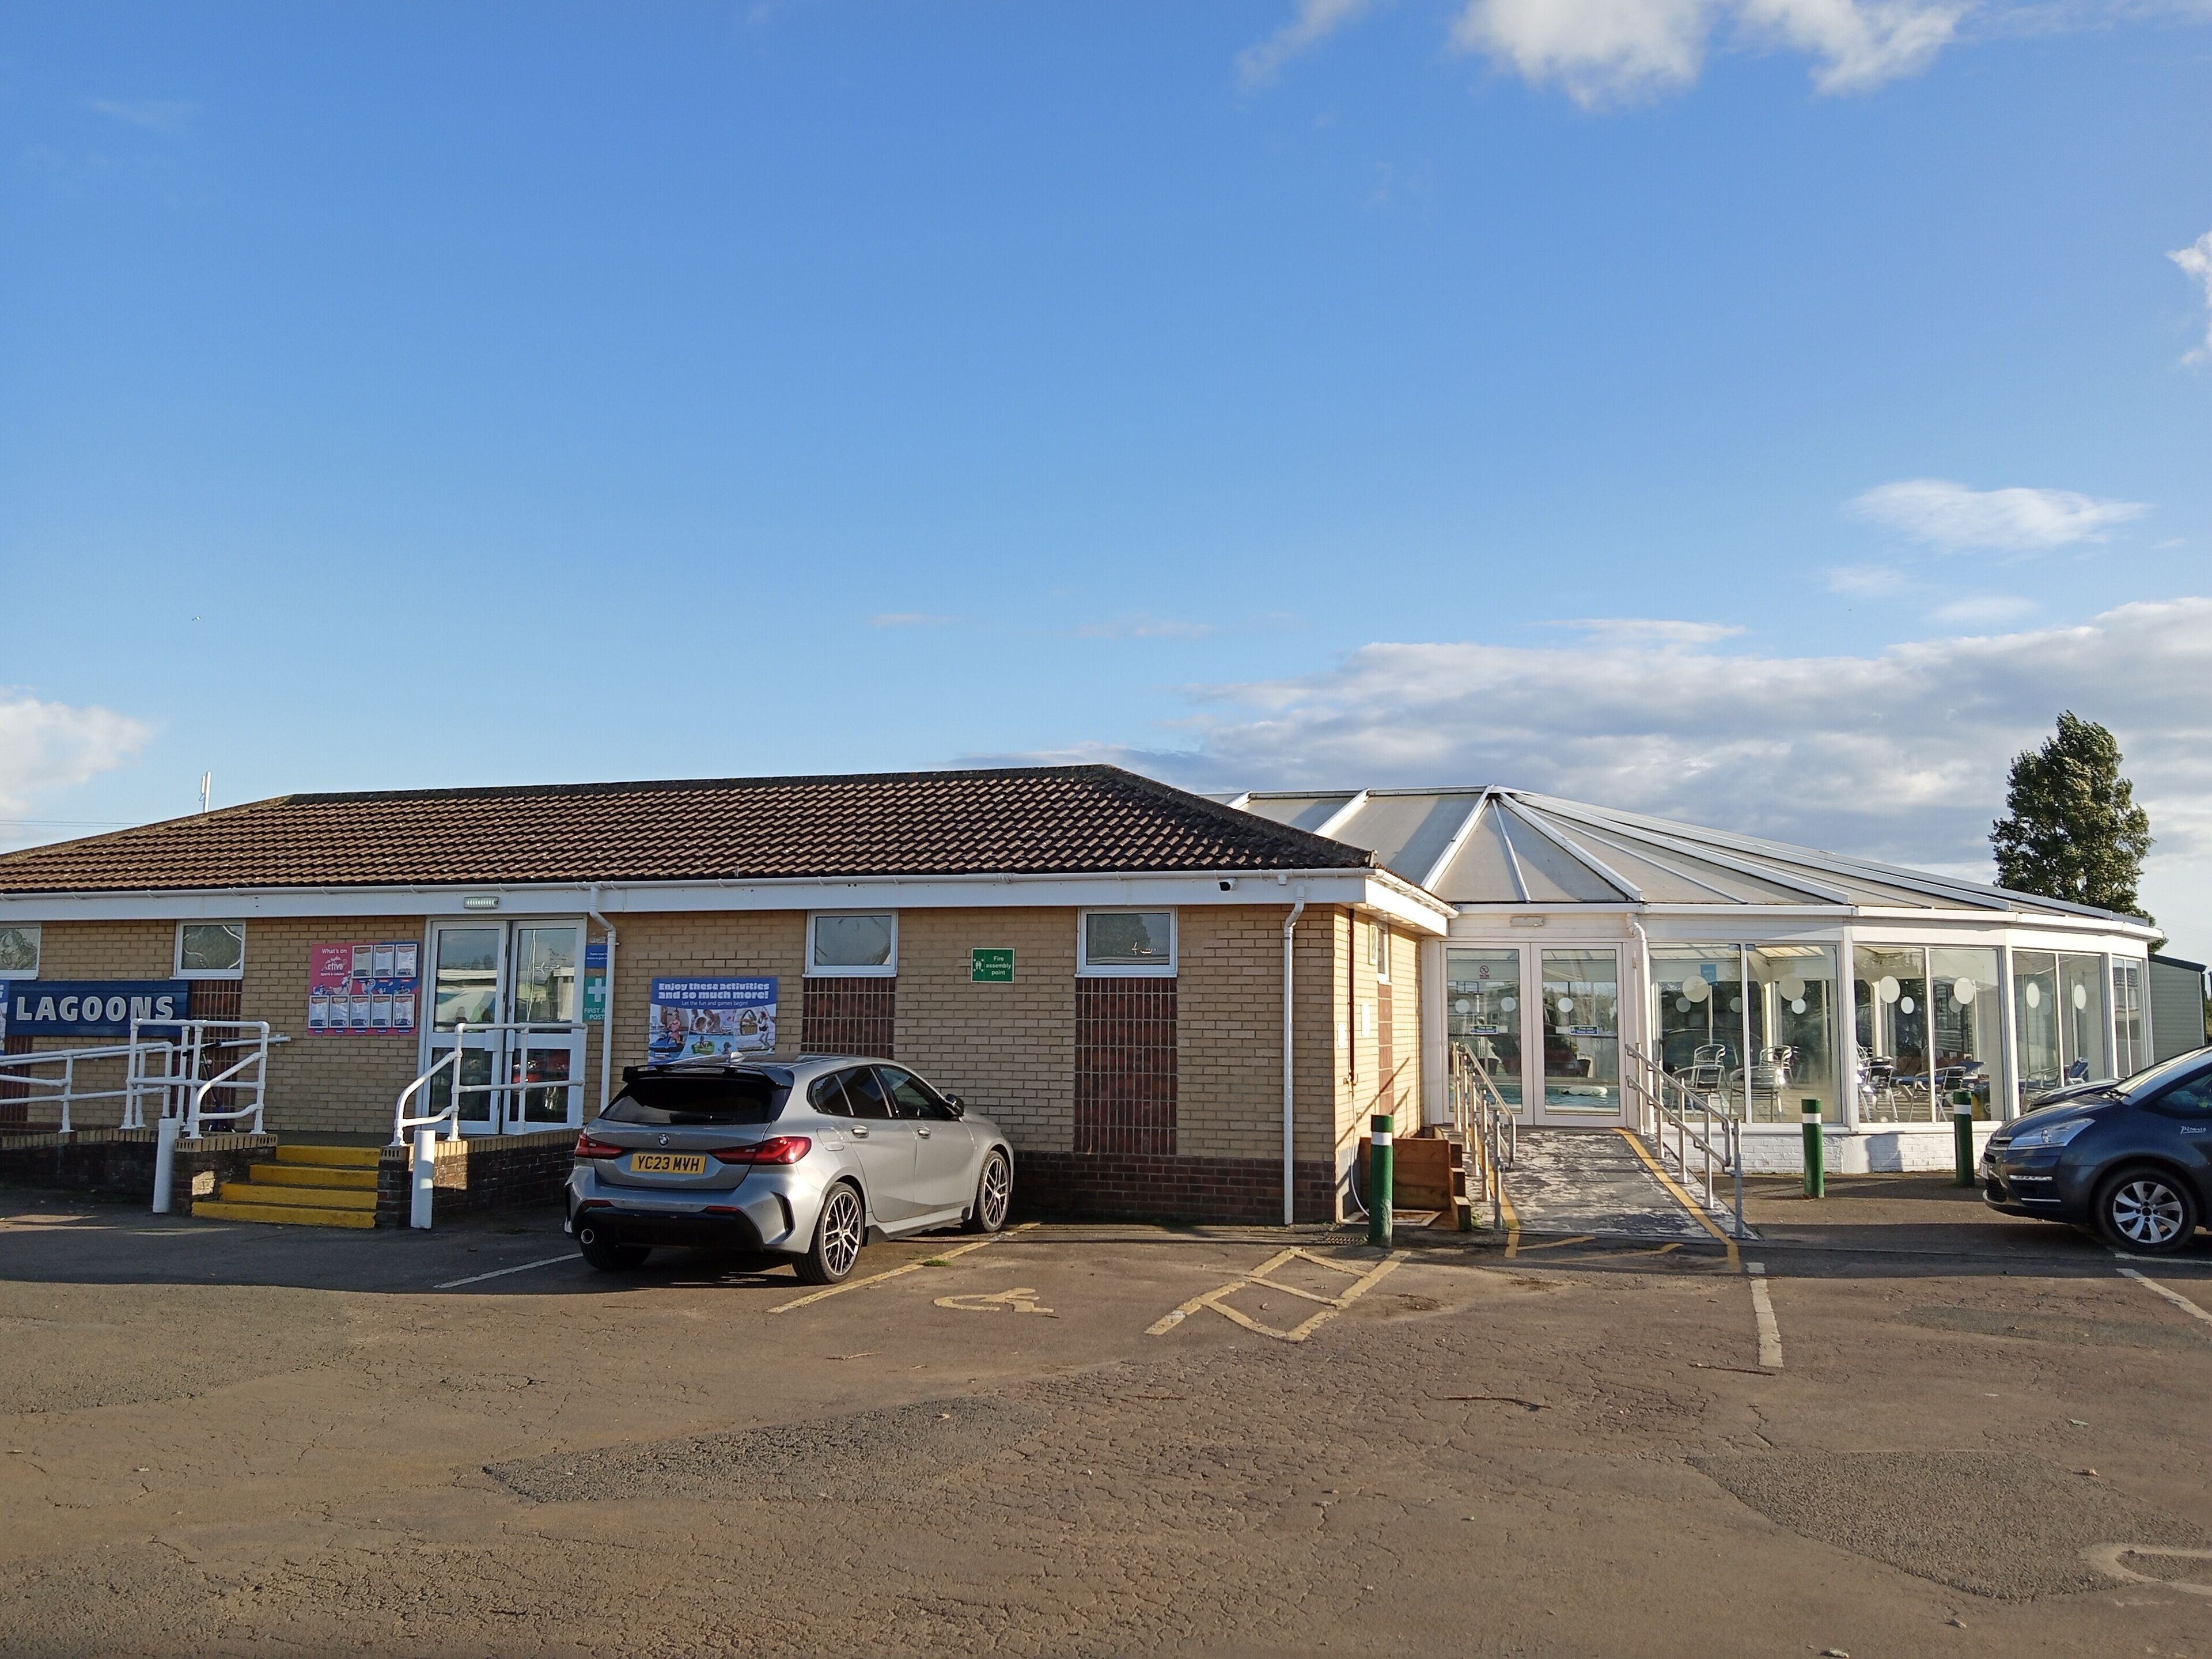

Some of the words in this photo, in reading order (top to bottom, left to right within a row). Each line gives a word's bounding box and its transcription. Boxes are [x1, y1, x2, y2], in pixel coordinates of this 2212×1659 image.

[658, 983, 688, 991] Enjoy
[658, 991, 680, 999] and
[698, 991, 731, 999] much
[733, 991, 769, 999] more!
[16, 996, 173, 1021] LAGOONS
[638, 1156, 671, 1170] YC23
[672, 1157, 700, 1171] MVH
